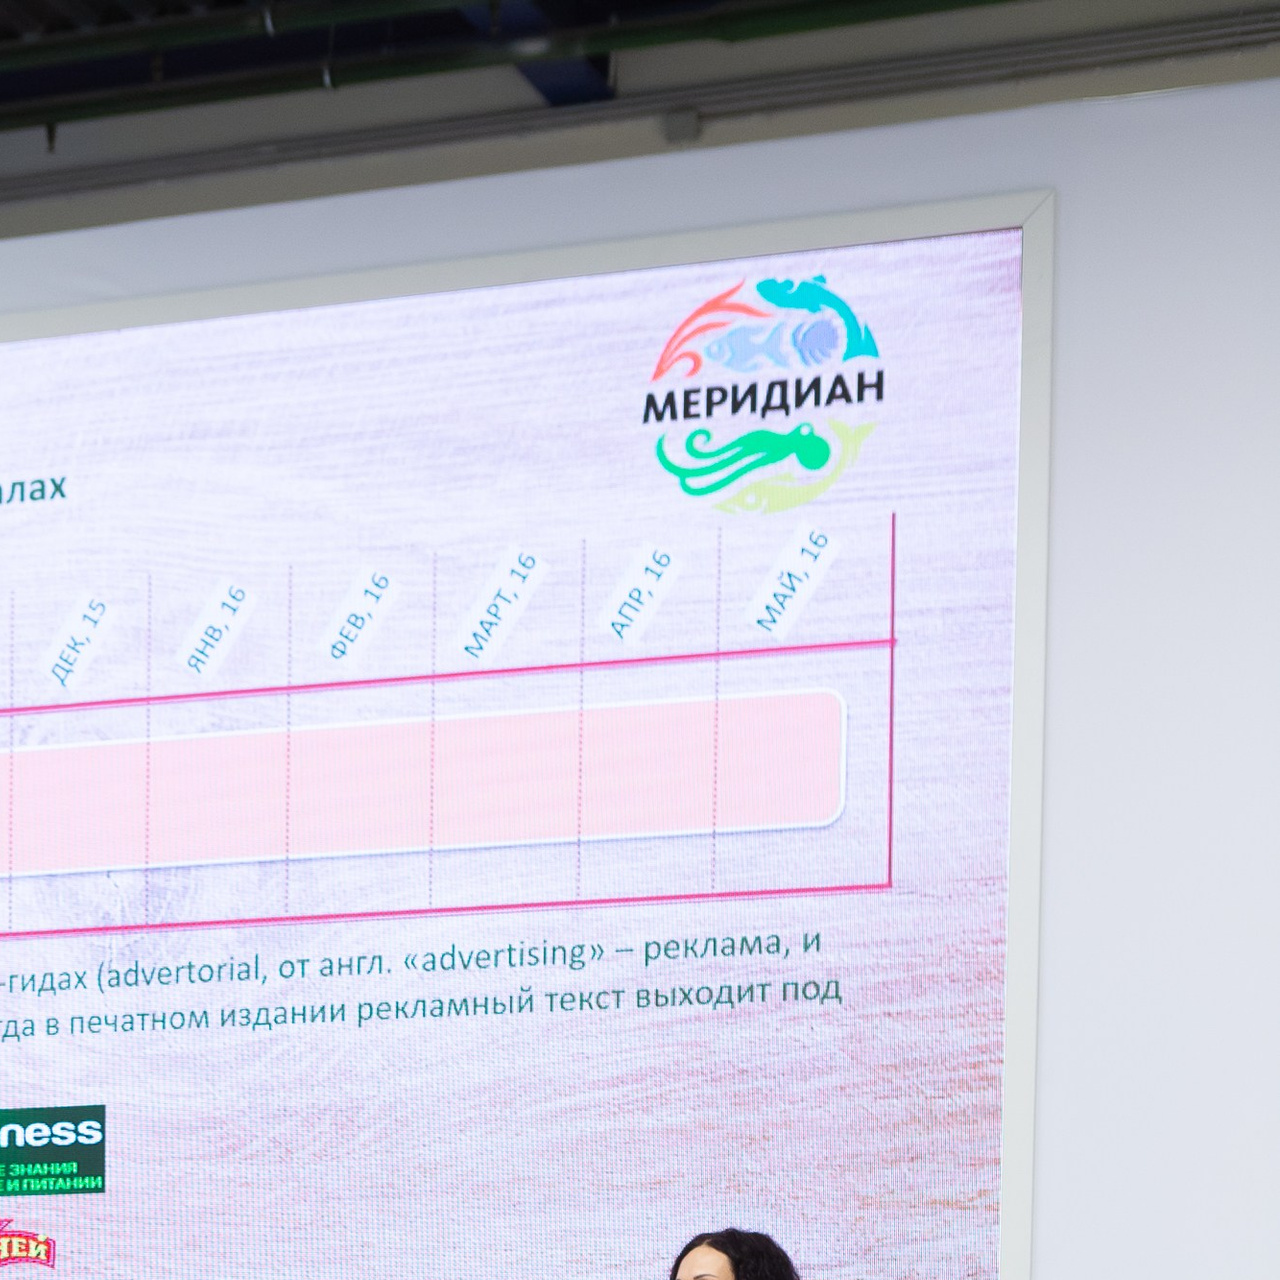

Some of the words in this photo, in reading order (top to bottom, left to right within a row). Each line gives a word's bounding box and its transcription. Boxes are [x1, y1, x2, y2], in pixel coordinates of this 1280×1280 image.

[642, 370, 885, 424] МЕРИДИАН
[330, 612, 373, 660] ФЕВ,
[363, 571, 390, 604] 16
[463, 588, 519, 659] МАРТ,
[510, 552, 536, 584] 16
[611, 586, 654, 640] АПР,
[644, 549, 671, 581] 16
[756, 570, 810, 632] МАЙ,
[800, 530, 828, 562] 16
[51, 636, 91, 688] ДЕК,
[82, 598, 106, 628] 15
[187, 623, 230, 674] ЯНВ,
[220, 585, 246, 616] 16
[97, 954, 268, 994] (advertorial,
[278, 958, 310, 979] от
[319, 953, 392, 977] англ.
[644, 932, 791, 967] реклама,
[802, 931, 822, 954] и
[46, 1016, 60, 1036] в
[70, 1009, 210, 1034] печатном
[220, 1002, 346, 1031] издании
[357, 985, 534, 1028] рекламный
[545, 989, 626, 1014] текст
[636, 981, 771, 1010] выходит
[782, 979, 842, 1006] под
[6, 1178, 20, 1192] И
[22, 1175, 104, 1192] ПИТАНИИ
[9, 1162, 78, 1177] ЗНАНИЯ
